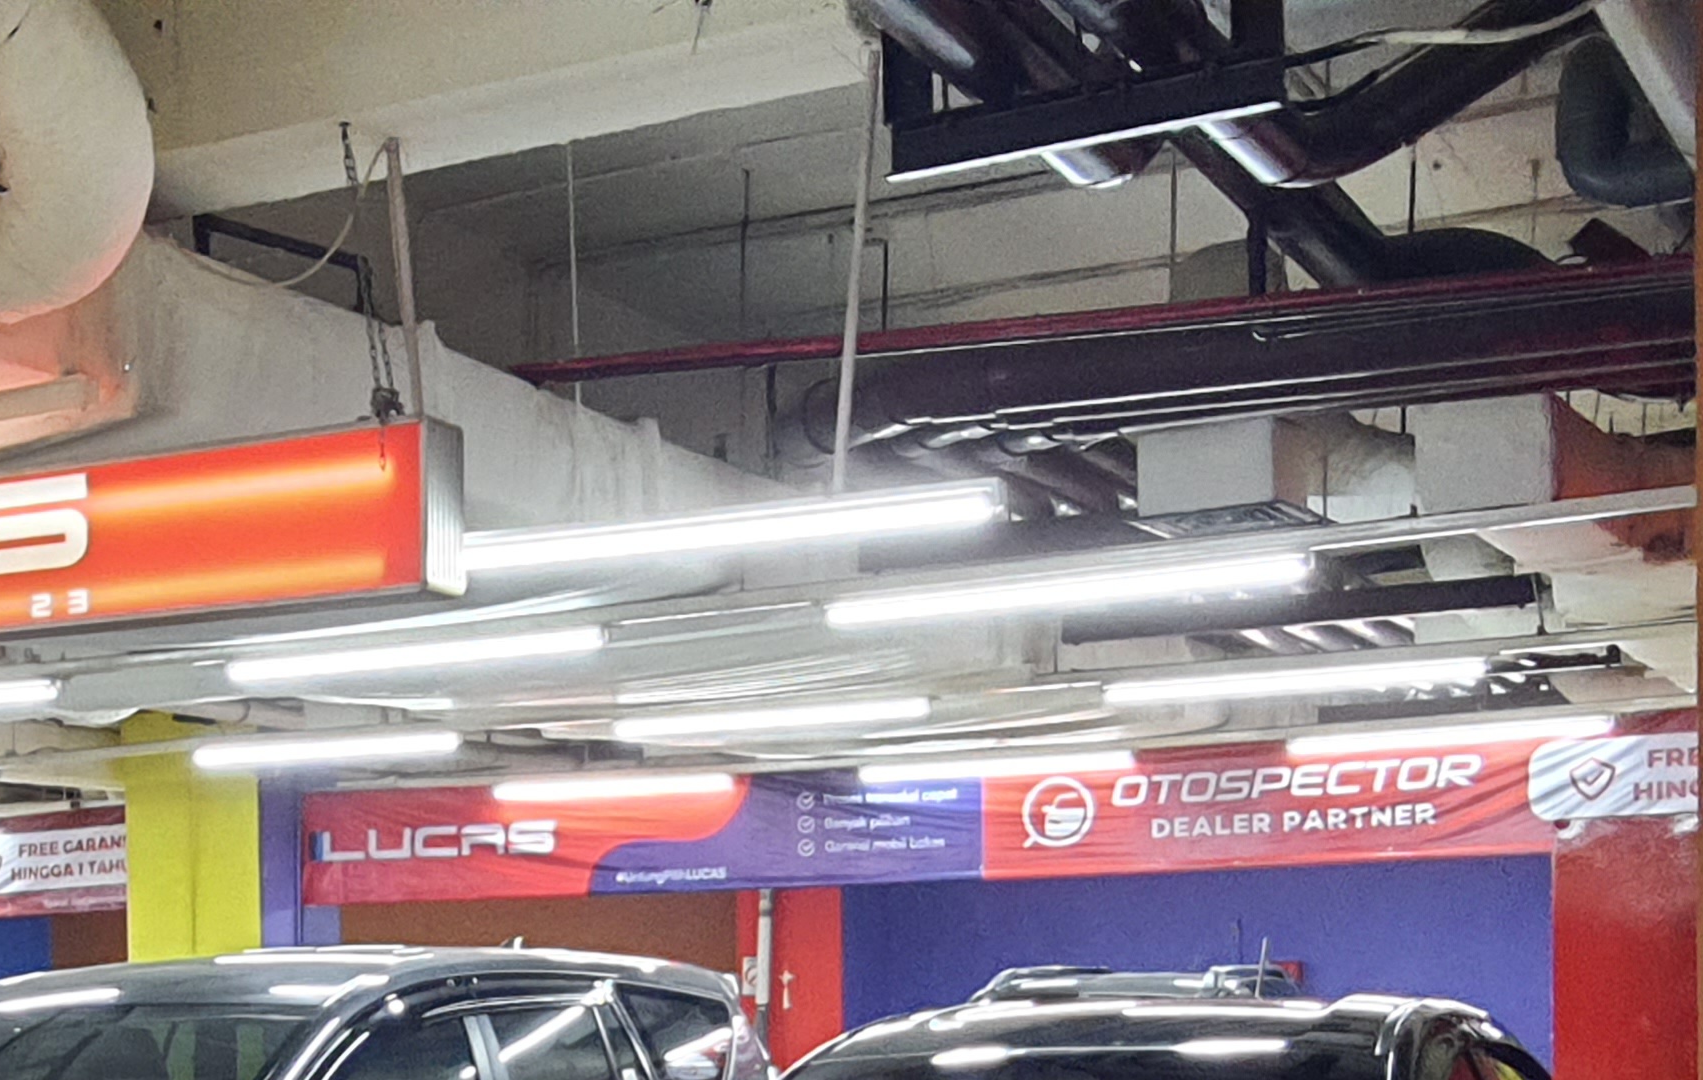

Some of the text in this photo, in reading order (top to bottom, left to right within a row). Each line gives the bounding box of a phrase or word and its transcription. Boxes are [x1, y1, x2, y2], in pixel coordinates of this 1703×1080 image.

[30, 588, 89, 618] 23
[1648, 747, 1700, 769] FRE
[1110, 753, 1483, 808] OTOSPECTOR
[1151, 803, 1438, 839] DEALER PARTNER
[18, 835, 127, 858] FREE GARAN
[321, 819, 559, 863] LUCAS
[11, 864, 74, 881] HINGGA
